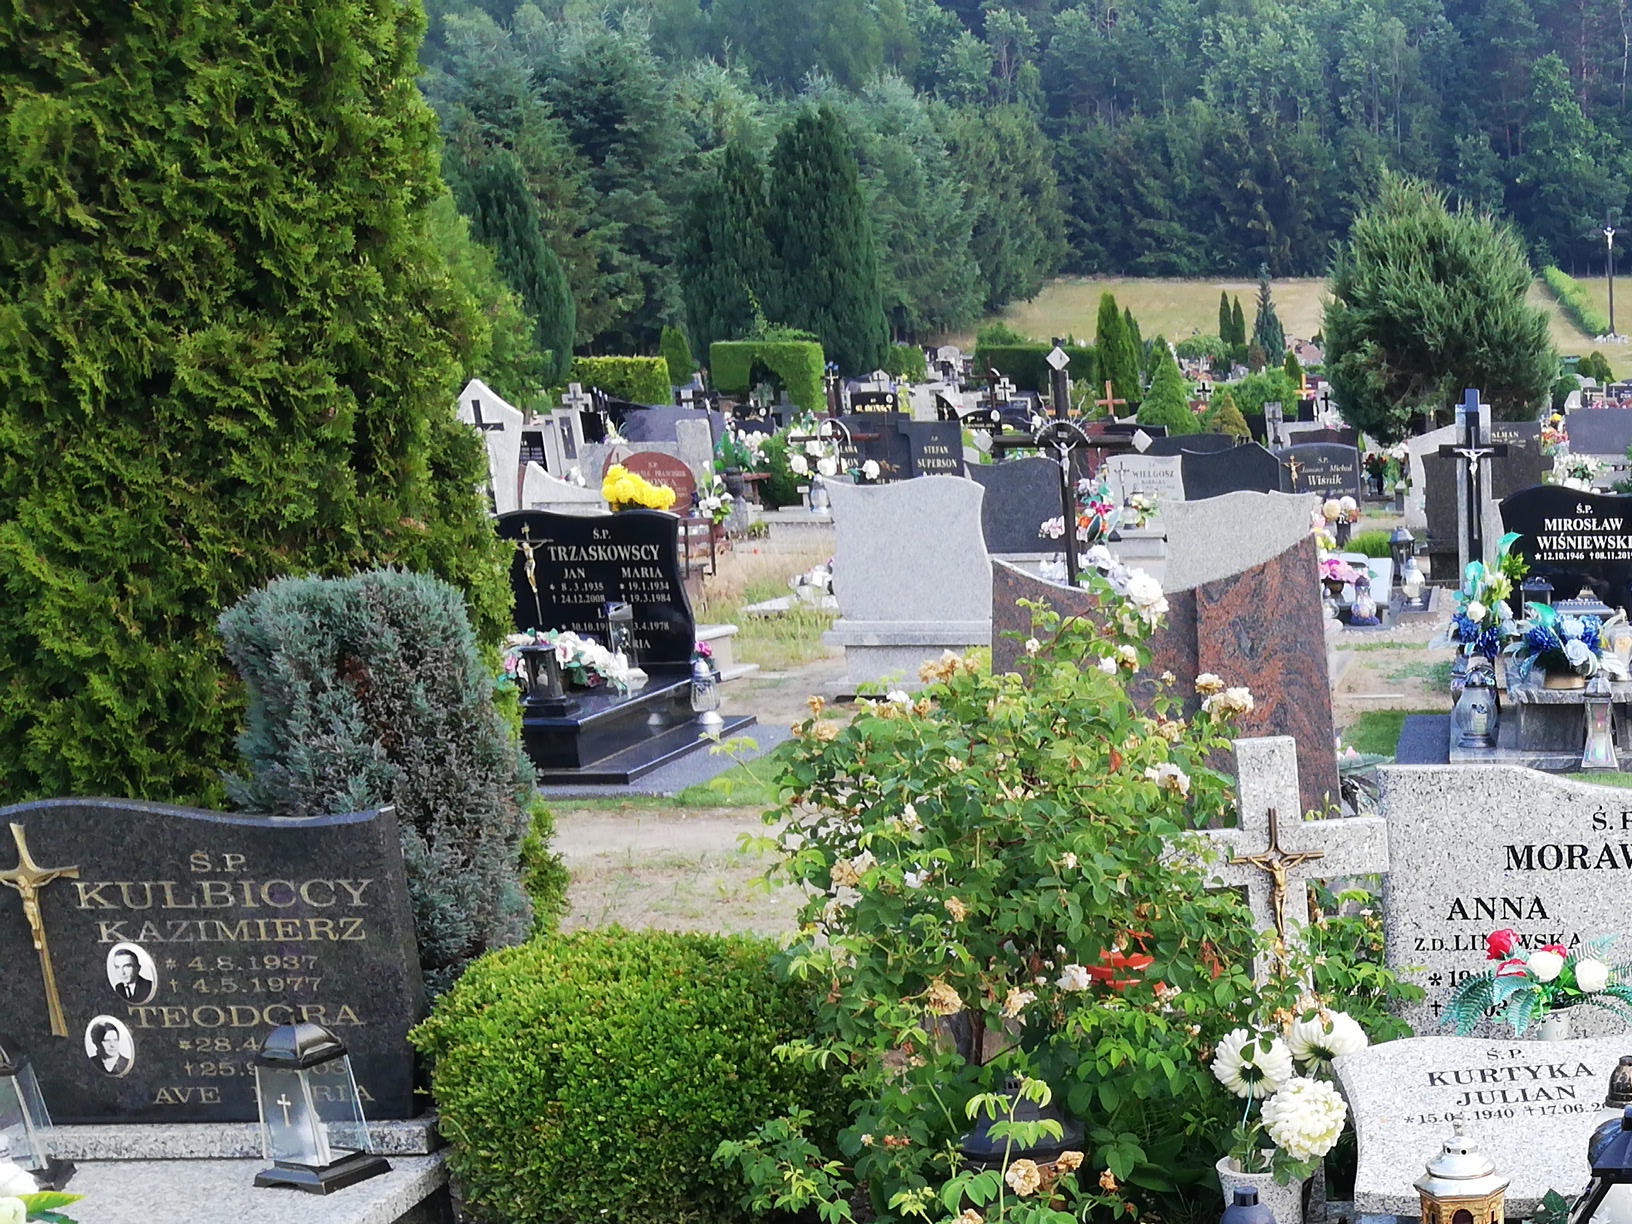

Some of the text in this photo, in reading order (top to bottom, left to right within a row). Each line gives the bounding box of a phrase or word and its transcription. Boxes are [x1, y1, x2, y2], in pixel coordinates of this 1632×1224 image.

[1576, 502, 1594, 514] Ś.P.
[1544, 517, 1624, 532] MIROSŁAW
[547, 544, 660, 562] TRZASKOWSCY
[1543, 552, 1585, 561] 12.10.1946
[563, 567, 586, 580] JAN
[621, 566, 664, 579] MARIA
[70, 877, 374, 911] KULBICCY
[1446, 895, 1551, 922] ANNA
[94, 916, 368, 944] KAZIMIERZ
[1426, 1062, 1597, 1088] KURTYKA
[152, 1086, 221, 1105] AVE
[1455, 1084, 1578, 1107] JULIAN
[1417, 1107, 1516, 1125] 15.0.1940
